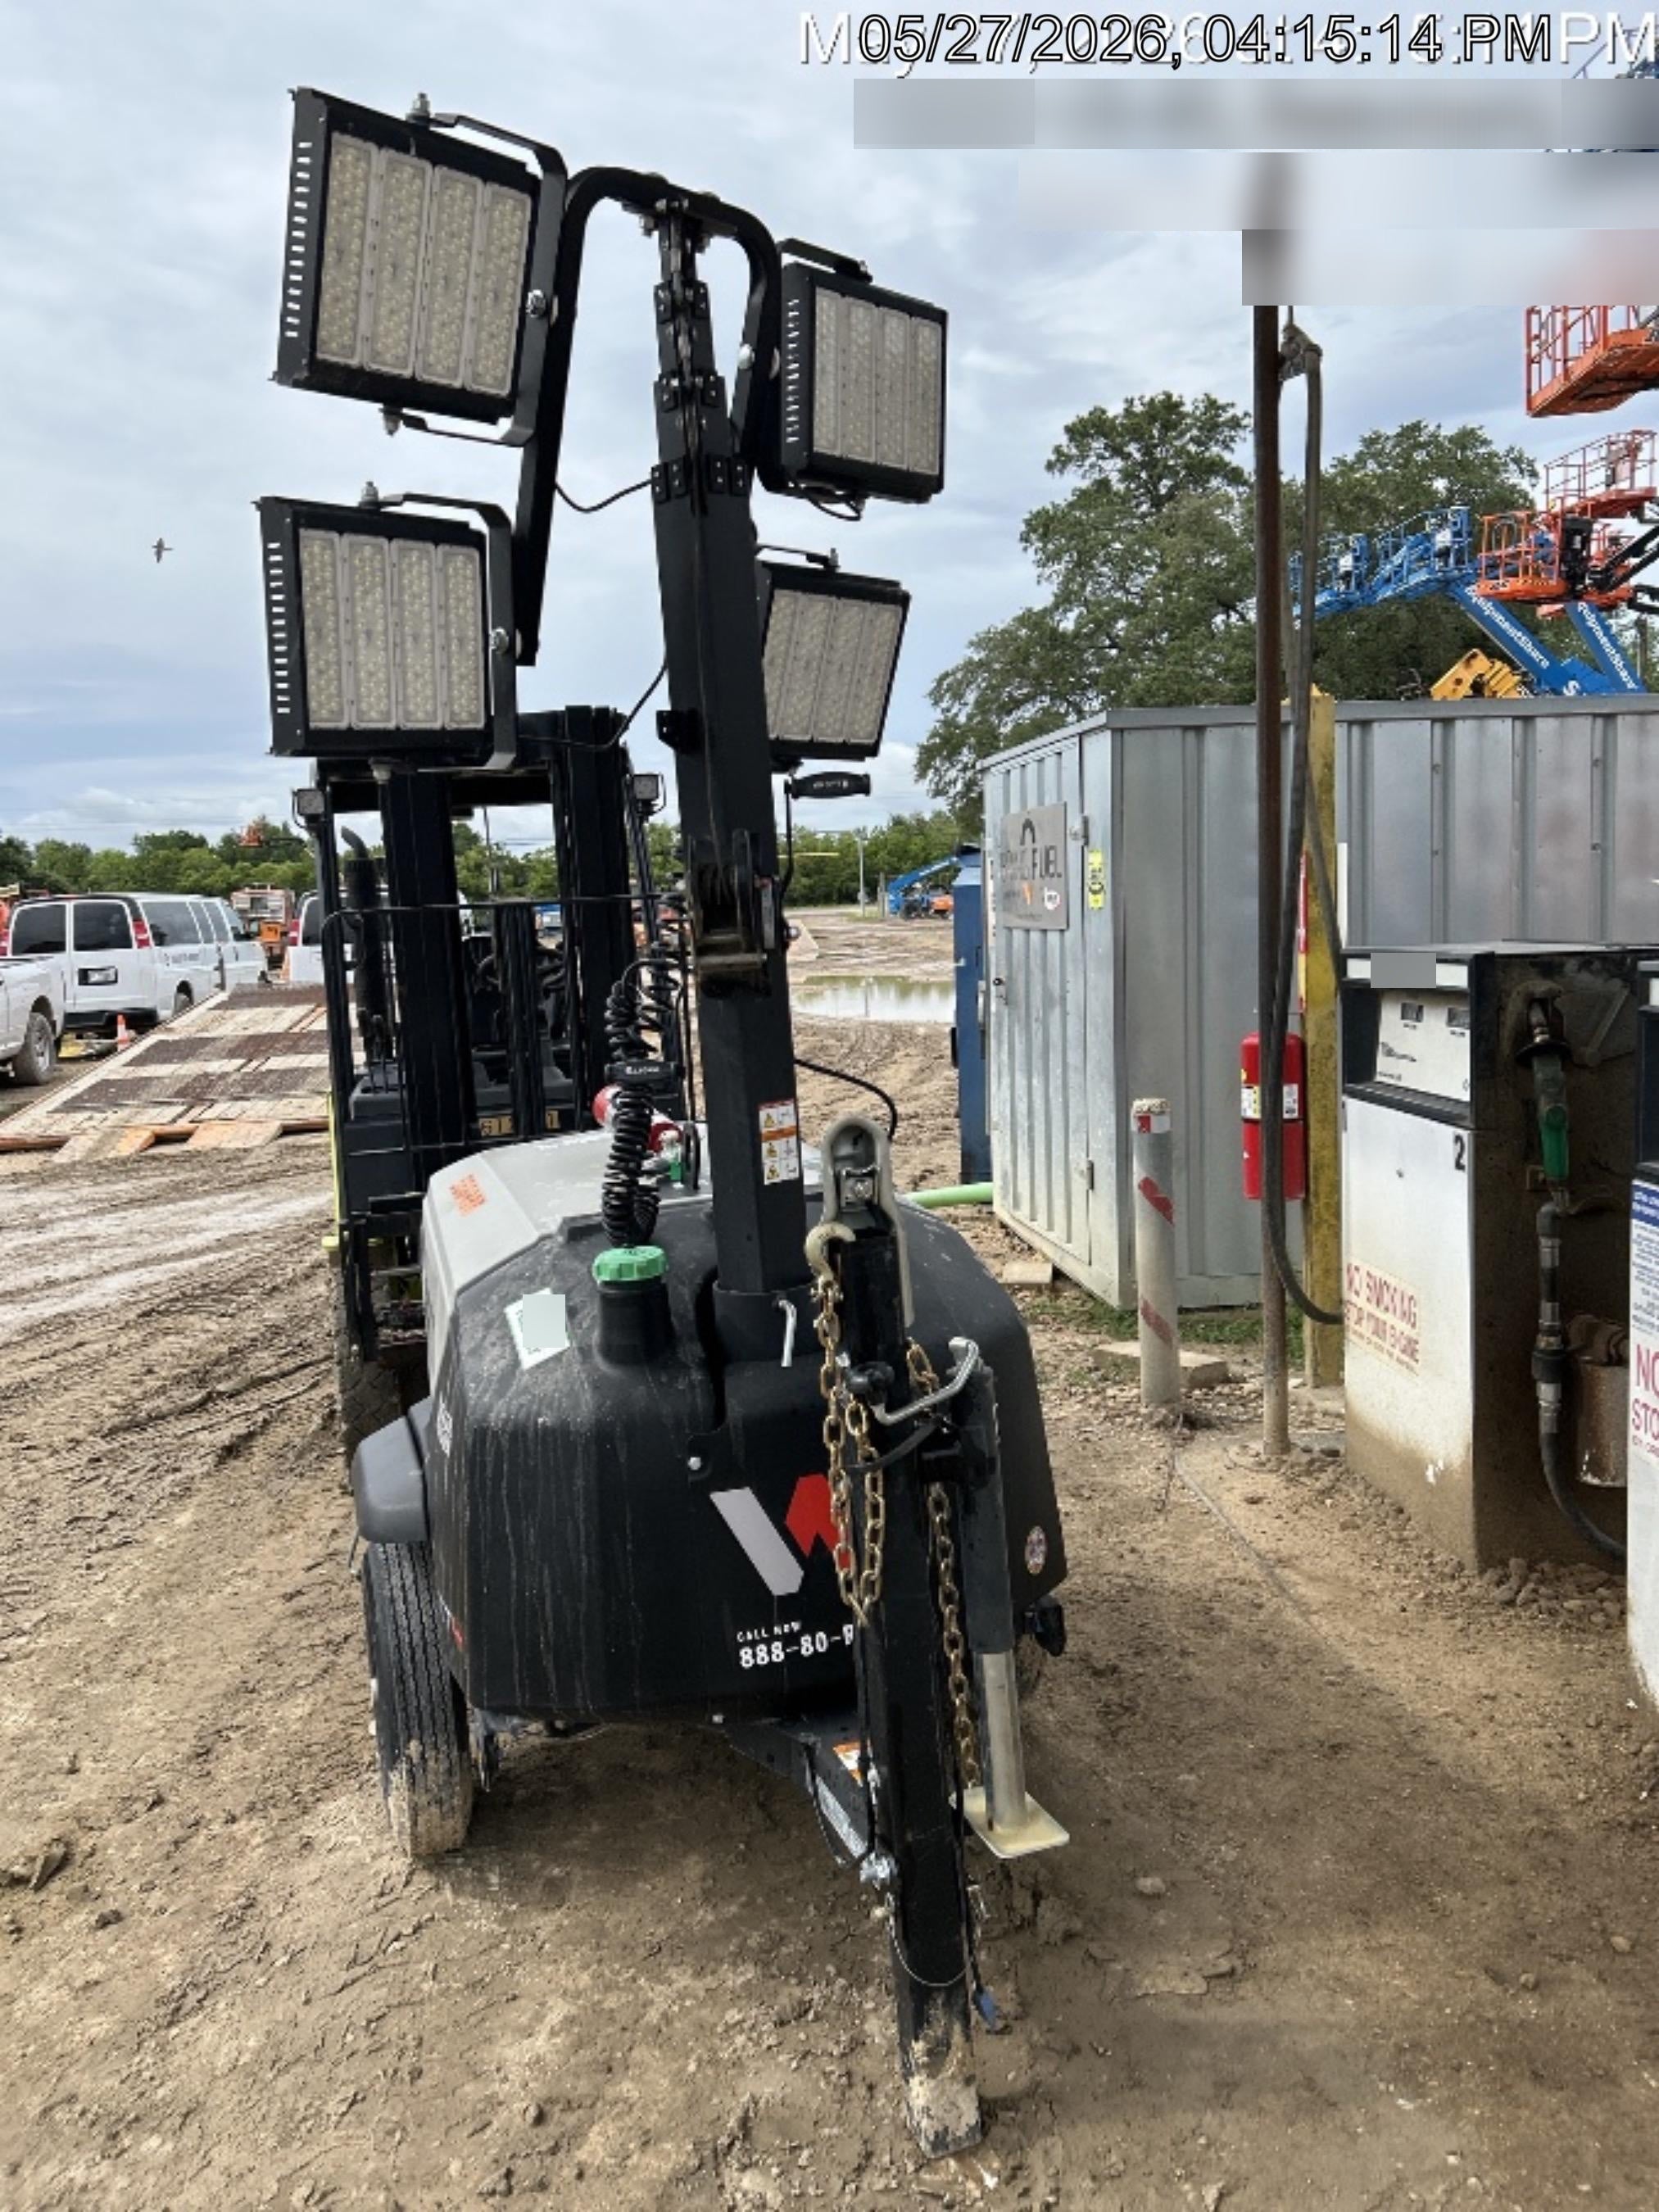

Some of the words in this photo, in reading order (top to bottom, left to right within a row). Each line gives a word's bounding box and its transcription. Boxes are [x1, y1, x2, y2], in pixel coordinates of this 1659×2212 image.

[1031, 845, 1063, 881] FUEL
[1453, 1134, 1466, 1172] 2
[1366, 1271, 1417, 1330] SMOKING
[737, 1626, 768, 1643] CALL
